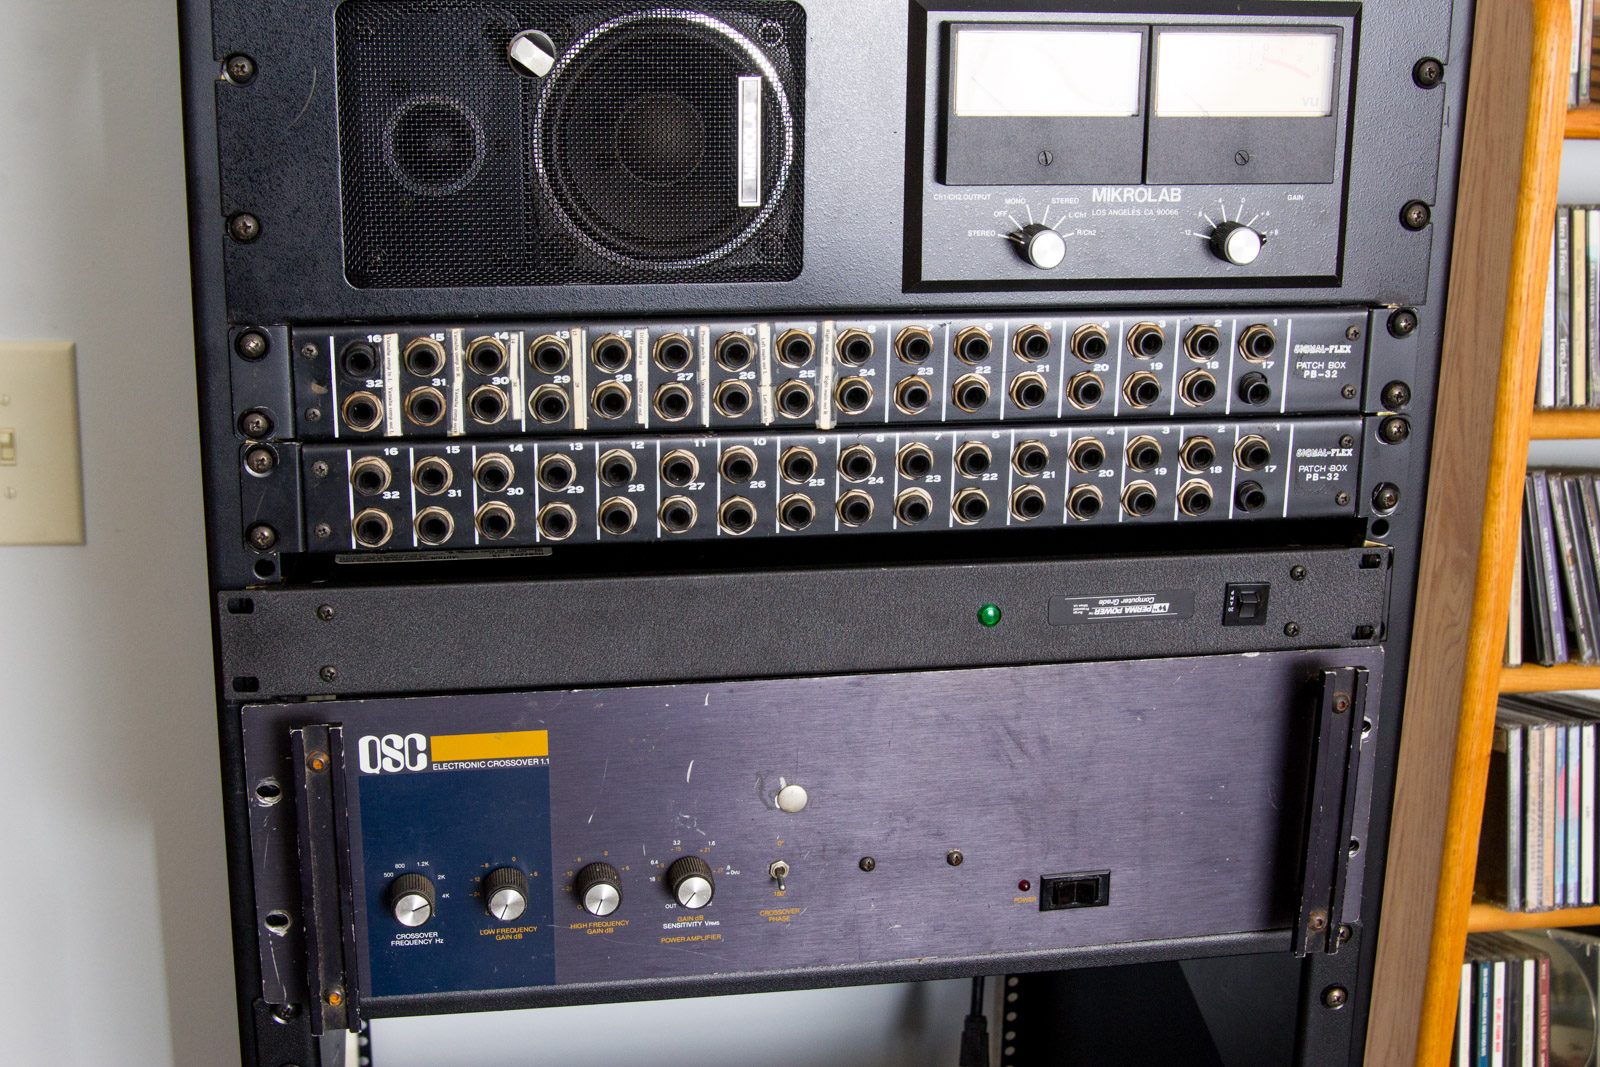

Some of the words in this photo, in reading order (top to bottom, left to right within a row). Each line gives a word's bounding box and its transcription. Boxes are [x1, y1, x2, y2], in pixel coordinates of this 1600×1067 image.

[743, 102, 756, 180] MIKROLAB
[1092, 187, 1181, 203] MIKROLAB
[985, 323, 993, 331] 6
[1043, 322, 1052, 330] 5
[1101, 321, 1110, 329] 4
[1158, 320, 1166, 328] 3
[1214, 319, 1223, 327] 2
[683, 328, 695, 336] 11
[867, 325, 876, 333] 8
[430, 333, 445, 341] 15
[494, 332, 509, 340] 14
[556, 331, 570, 339] 13
[618, 330, 632, 338] 12
[1294, 344, 1352, 354] SIGNAL-FLEX
[1150, 362, 1163, 370] 19
[1206, 361, 1219, 369] 18
[1261, 361, 1275, 369] 17
[1328, 361, 1346, 369] BOX
[799, 370, 816, 378] 25
[917, 367, 934, 375] 23
[975, 366, 992, 374] 22
[1304, 370, 1338, 378] PB-32
[553, 375, 571, 383] 29
[615, 374, 632, 382] 28
[739, 371, 756, 379] 26
[366, 380, 383, 388] 32
[432, 378, 446, 386] 31
[492, 377, 509, 385] 30
[1106, 428, 1115, 436] 4
[1162, 426, 1170, 434] 3
[1218, 425, 1226, 433] 2
[876, 434, 884, 442] 8
[991, 431, 1000, 439] 6
[753, 438, 766, 446] 10
[817, 436, 826, 444] 9
[508, 444, 523, 452] 14
[630, 441, 645, 449] 12
[384, 448, 398, 456] 16
[446, 446, 460, 454] 15
[1296, 449, 1353, 457] SIGNAL-FLEX
[1210, 466, 1223, 474] 18
[1264, 465, 1277, 473] 17
[1329, 464, 1348, 472] BOX
[925, 475, 941, 483] 23
[982, 473, 998, 481] 22
[1042, 471, 1056, 479] 21
[1306, 473, 1339, 481] PB-32
[868, 477, 884, 485] 24
[506, 487, 524, 496] 30
[567, 486, 584, 494] 29
[628, 484, 645, 492] 28
[383, 491, 400, 499] 32
[1094, 607, 1122, 615] POWER
[1125, 605, 1154, 613] PERMA
[358, 733, 427, 774] QSC
[433, 761, 486, 771] ELECTRONIC
[487, 759, 539, 768] CROSSOVER
[760, 908, 800, 917] CROSSOVER
[589, 920, 630, 928] FREQUENCY
[496, 926, 538, 934] FREQUENCY
